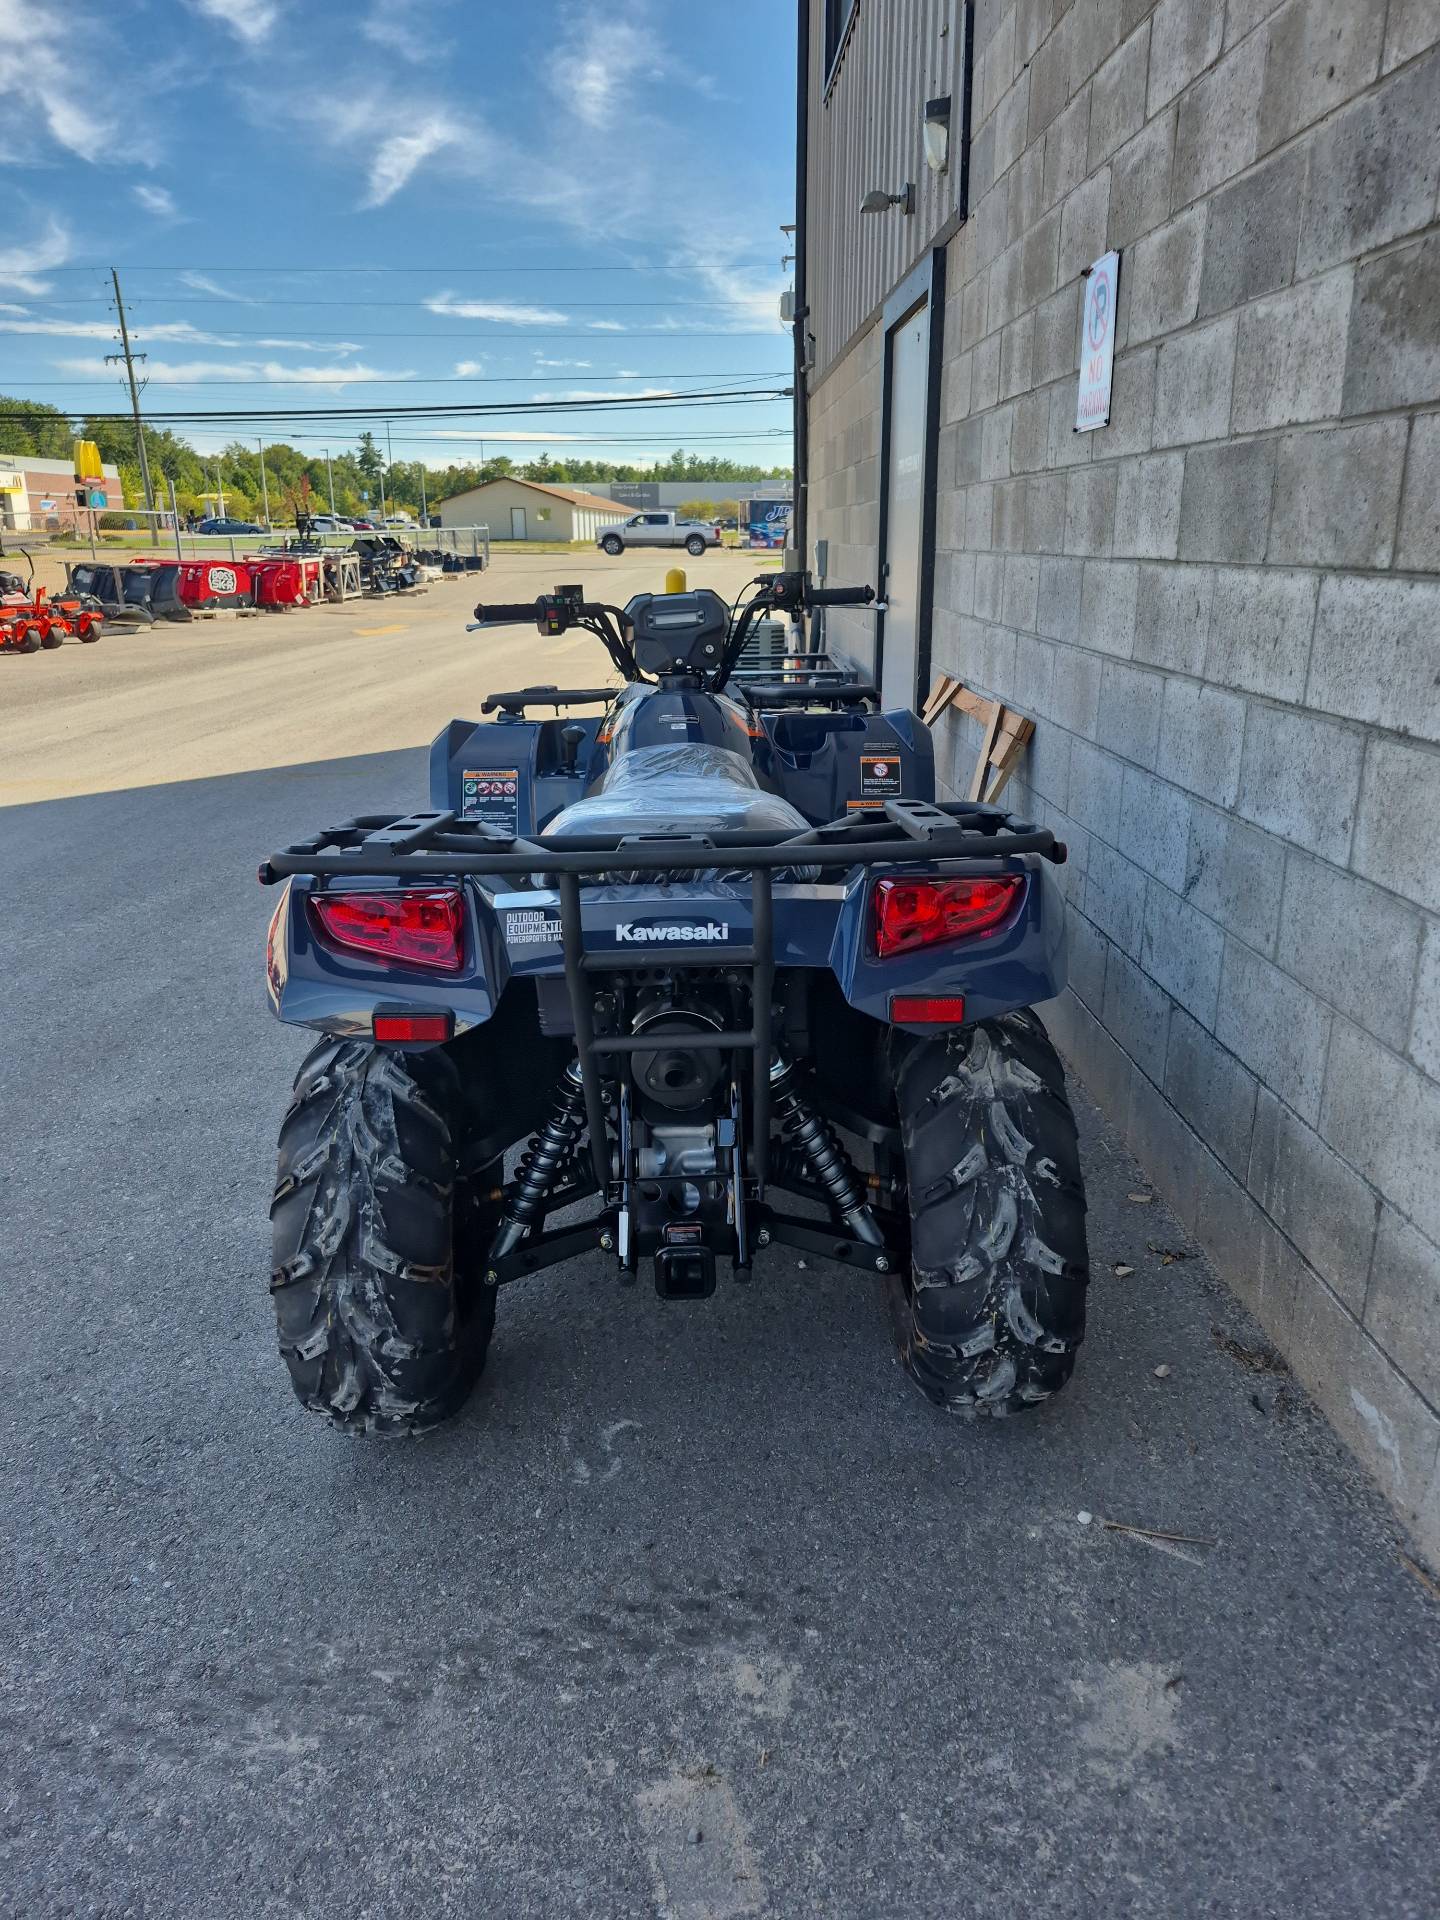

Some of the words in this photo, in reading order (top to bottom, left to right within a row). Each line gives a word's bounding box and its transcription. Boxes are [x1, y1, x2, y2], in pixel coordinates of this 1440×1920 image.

[1089, 355, 1103, 385] NO
[1080, 389, 1109, 418] PARKING
[506, 911, 545, 923] OUTDOOR
[508, 920, 557, 934] EQUIPMENT
[615, 922, 729, 942] Kawasaki
[506, 934, 547, 944] POWERSPORTS
[547, 933, 552, 942] &
